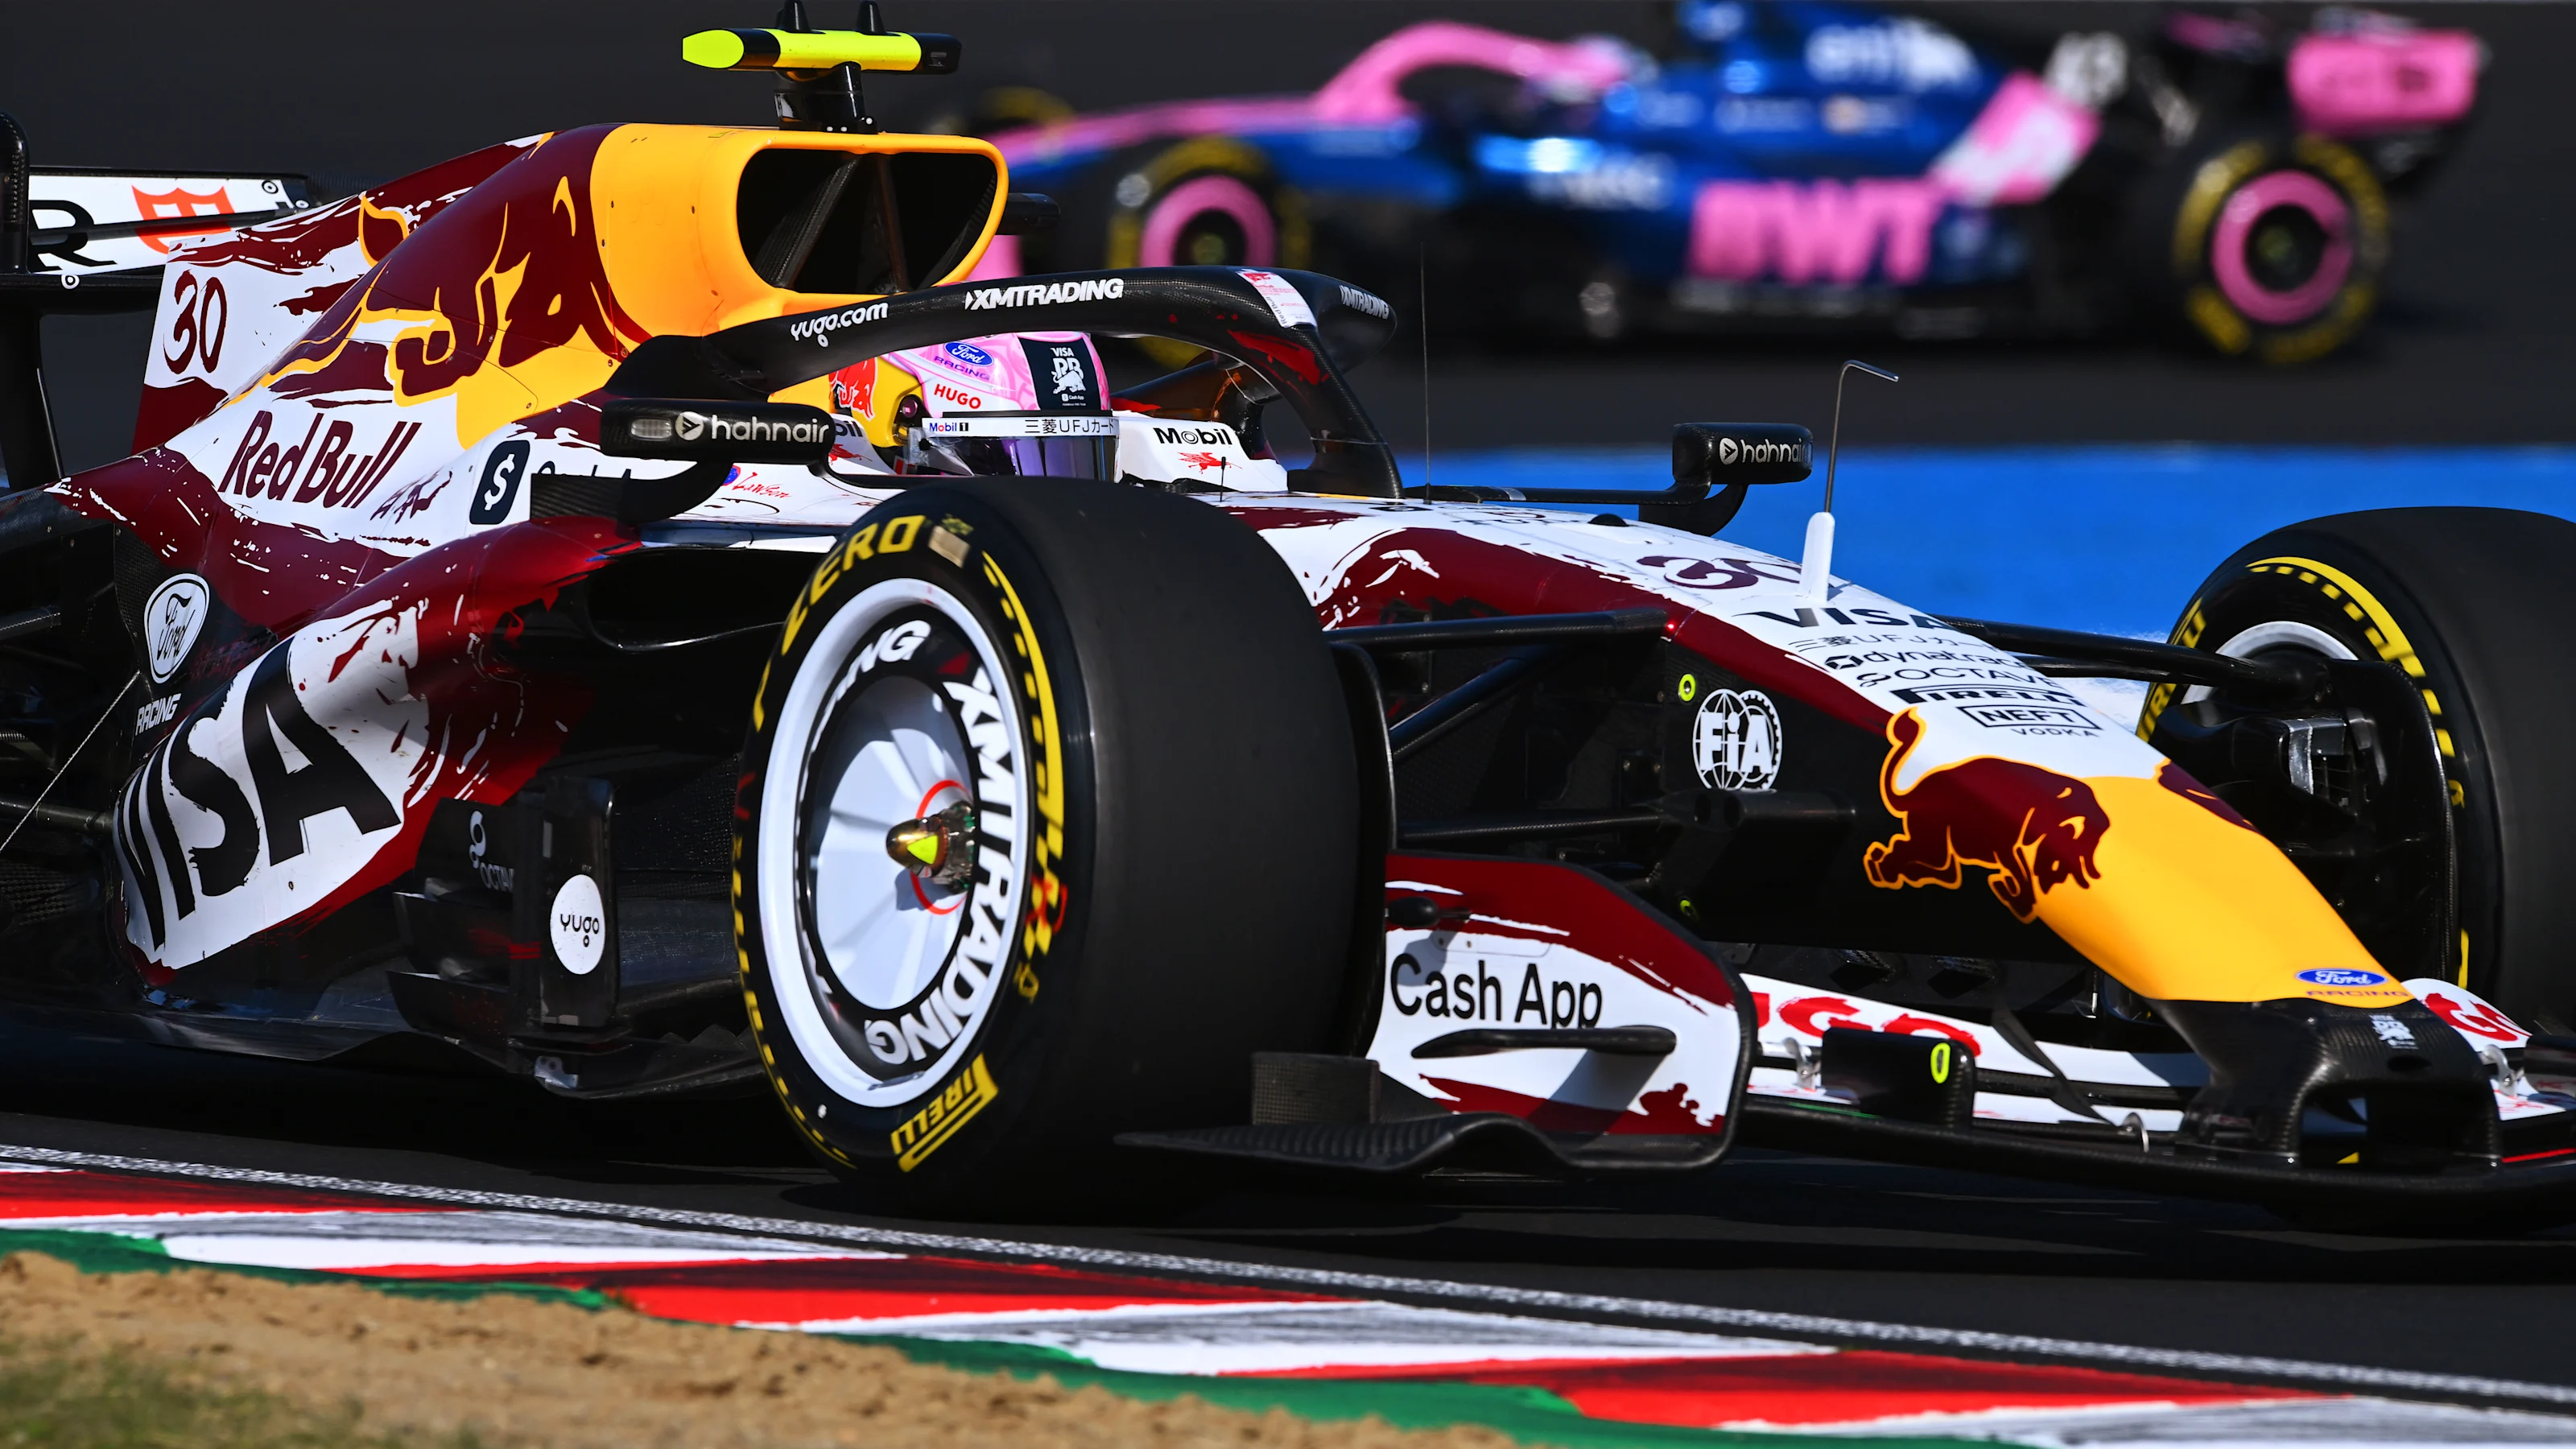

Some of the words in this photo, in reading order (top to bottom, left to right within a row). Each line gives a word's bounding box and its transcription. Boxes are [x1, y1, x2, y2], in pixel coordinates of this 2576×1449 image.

[967, 278, 1125, 311] XMTRADING
[1340, 285, 1389, 320] XMTRADING
[163, 269, 228, 374] 30
[791, 302, 889, 348] yugo.com
[1050, 347, 1075, 357] VISA
[934, 356, 991, 380] RACING
[934, 383, 981, 409] HUGO
[712, 415, 829, 444] hahnair
[930, 423, 957, 431] Mobil
[1153, 427, 1233, 445] Mobil
[218, 410, 324, 499] Red
[293, 419, 423, 509] Bull
[781, 514, 926, 656] ZERO
[1732, 607, 1959, 630] VISA
[1862, 650, 2032, 671] dynatrace
[1894, 667, 2063, 689] OCTAVE
[1890, 683, 2087, 708] PIRELLI
[135, 693, 182, 736] RACING
[1976, 709, 2078, 724] NEFT
[2010, 728, 2100, 738] VODKA
[114, 636, 402, 953] VISA
[480, 862, 514, 892] OCTAV
[560, 914, 600, 947] yugo
[1390, 953, 1502, 1022] Cash
[1514, 963, 1602, 1028] App
[890, 1053, 999, 1173] PIRELLI
